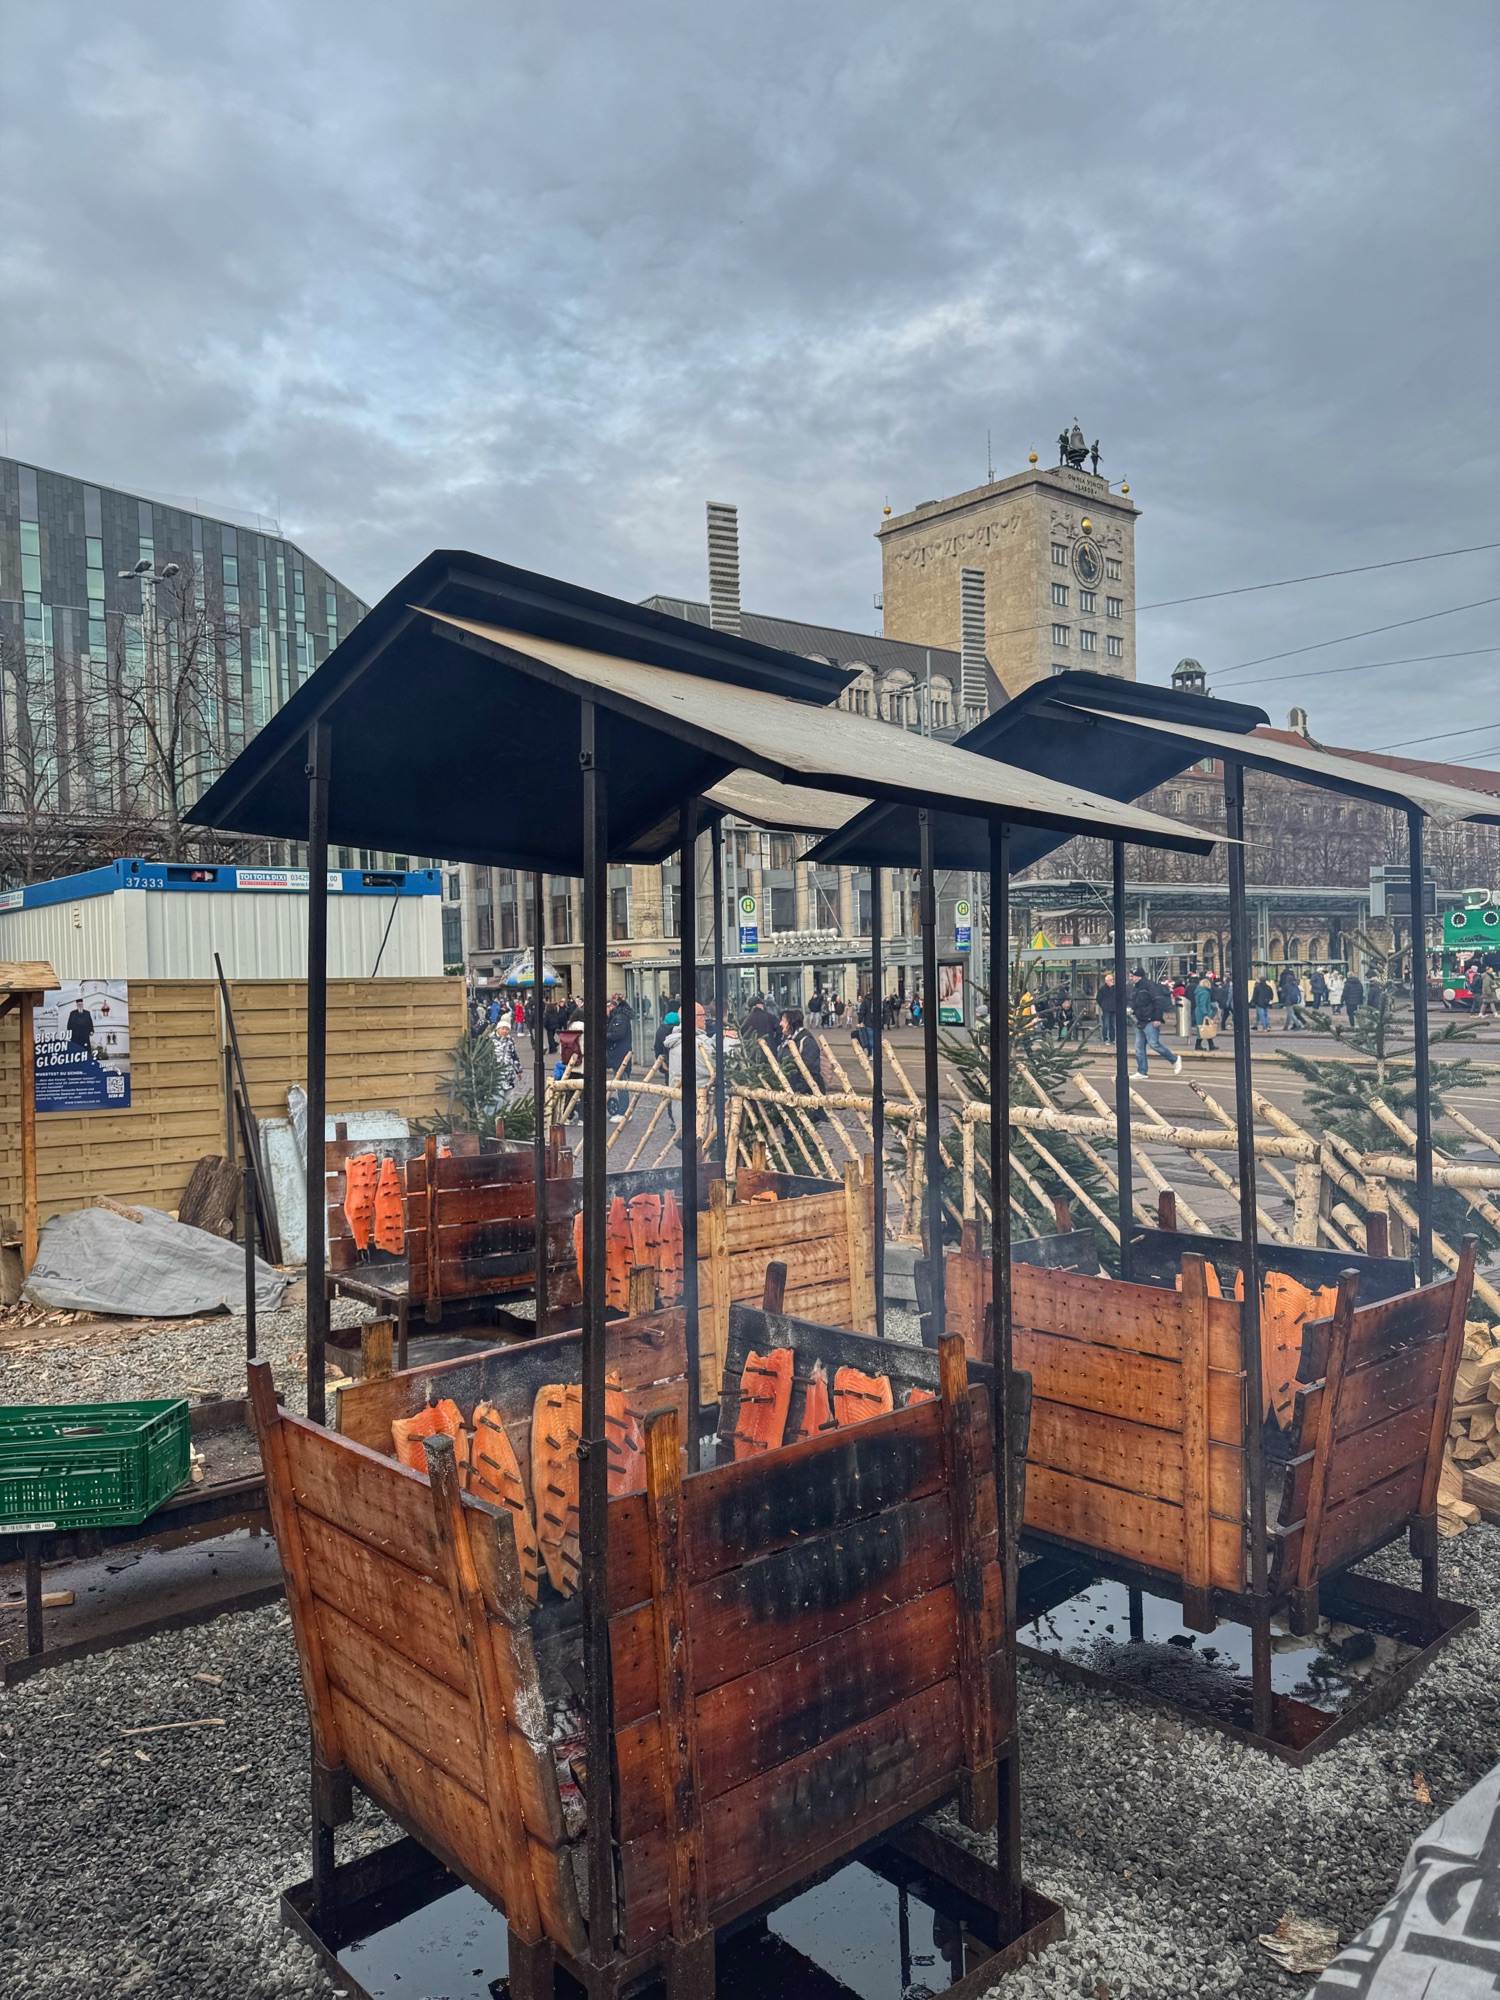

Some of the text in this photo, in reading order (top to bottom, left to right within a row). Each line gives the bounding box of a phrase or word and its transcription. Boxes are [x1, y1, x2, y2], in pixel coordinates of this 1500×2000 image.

[125, 877, 164, 888] 37333
[35, 1030, 72, 1044] BIST DU
[35, 1041, 68, 1055] SCHON
[36, 1051, 88, 1068] GLÖGLICH
